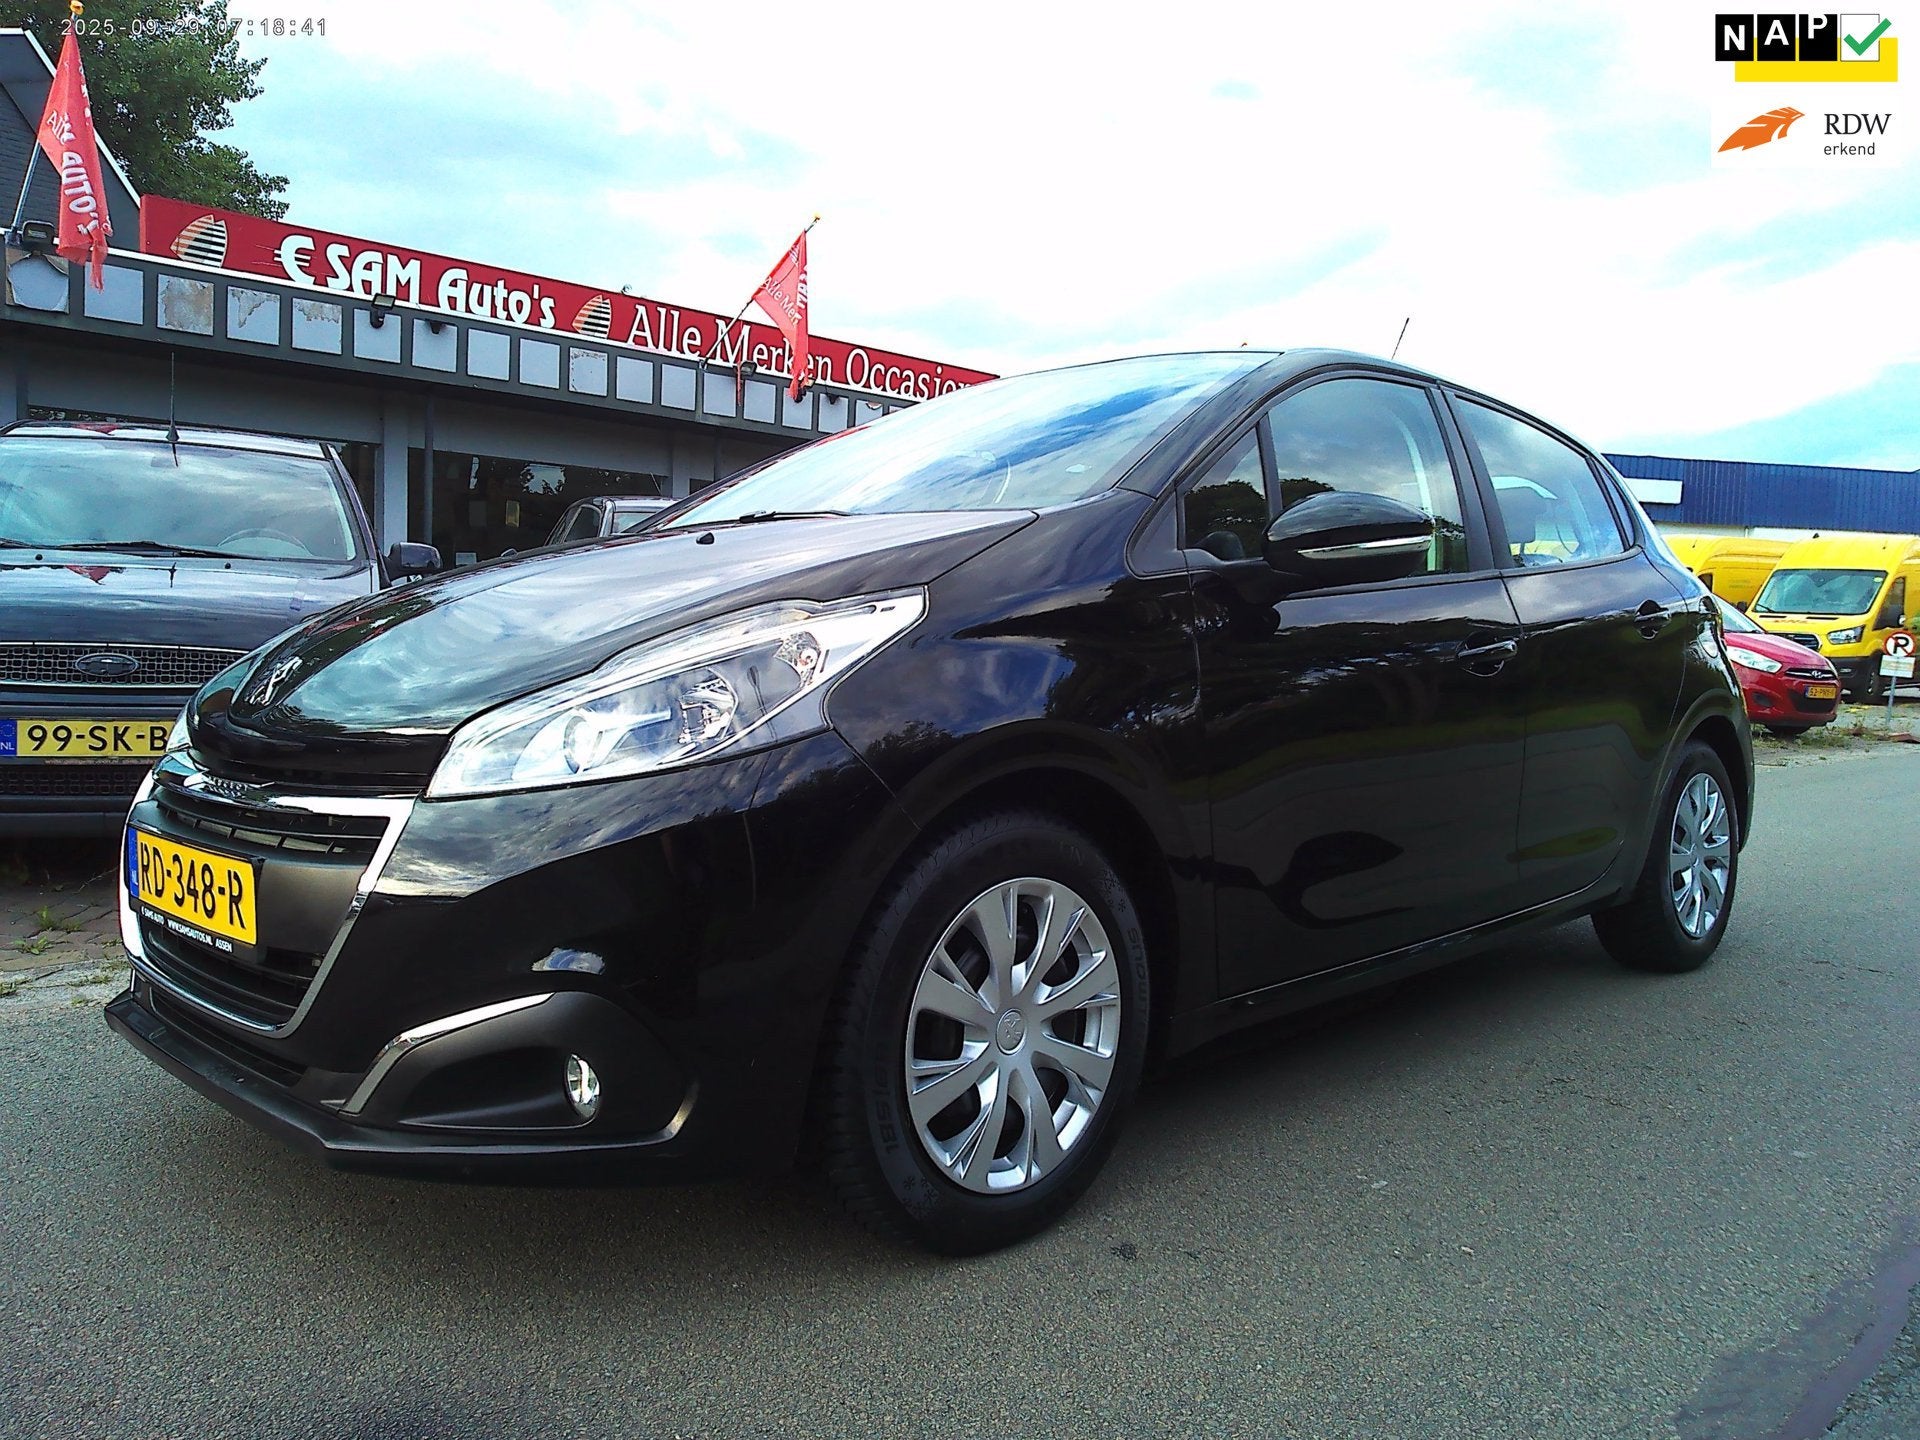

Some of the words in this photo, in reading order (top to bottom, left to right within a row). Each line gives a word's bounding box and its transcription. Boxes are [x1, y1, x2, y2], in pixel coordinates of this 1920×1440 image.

[325, 244, 421, 304] SAM
[437, 268, 556, 330] Auto's
[626, 304, 702, 357] Alle
[846, 348, 971, 400] Occasio
[0, 742, 15, 751] NL
[27, 724, 168, 751] 99-SK-B
[140, 842, 247, 929] RD-348-R
